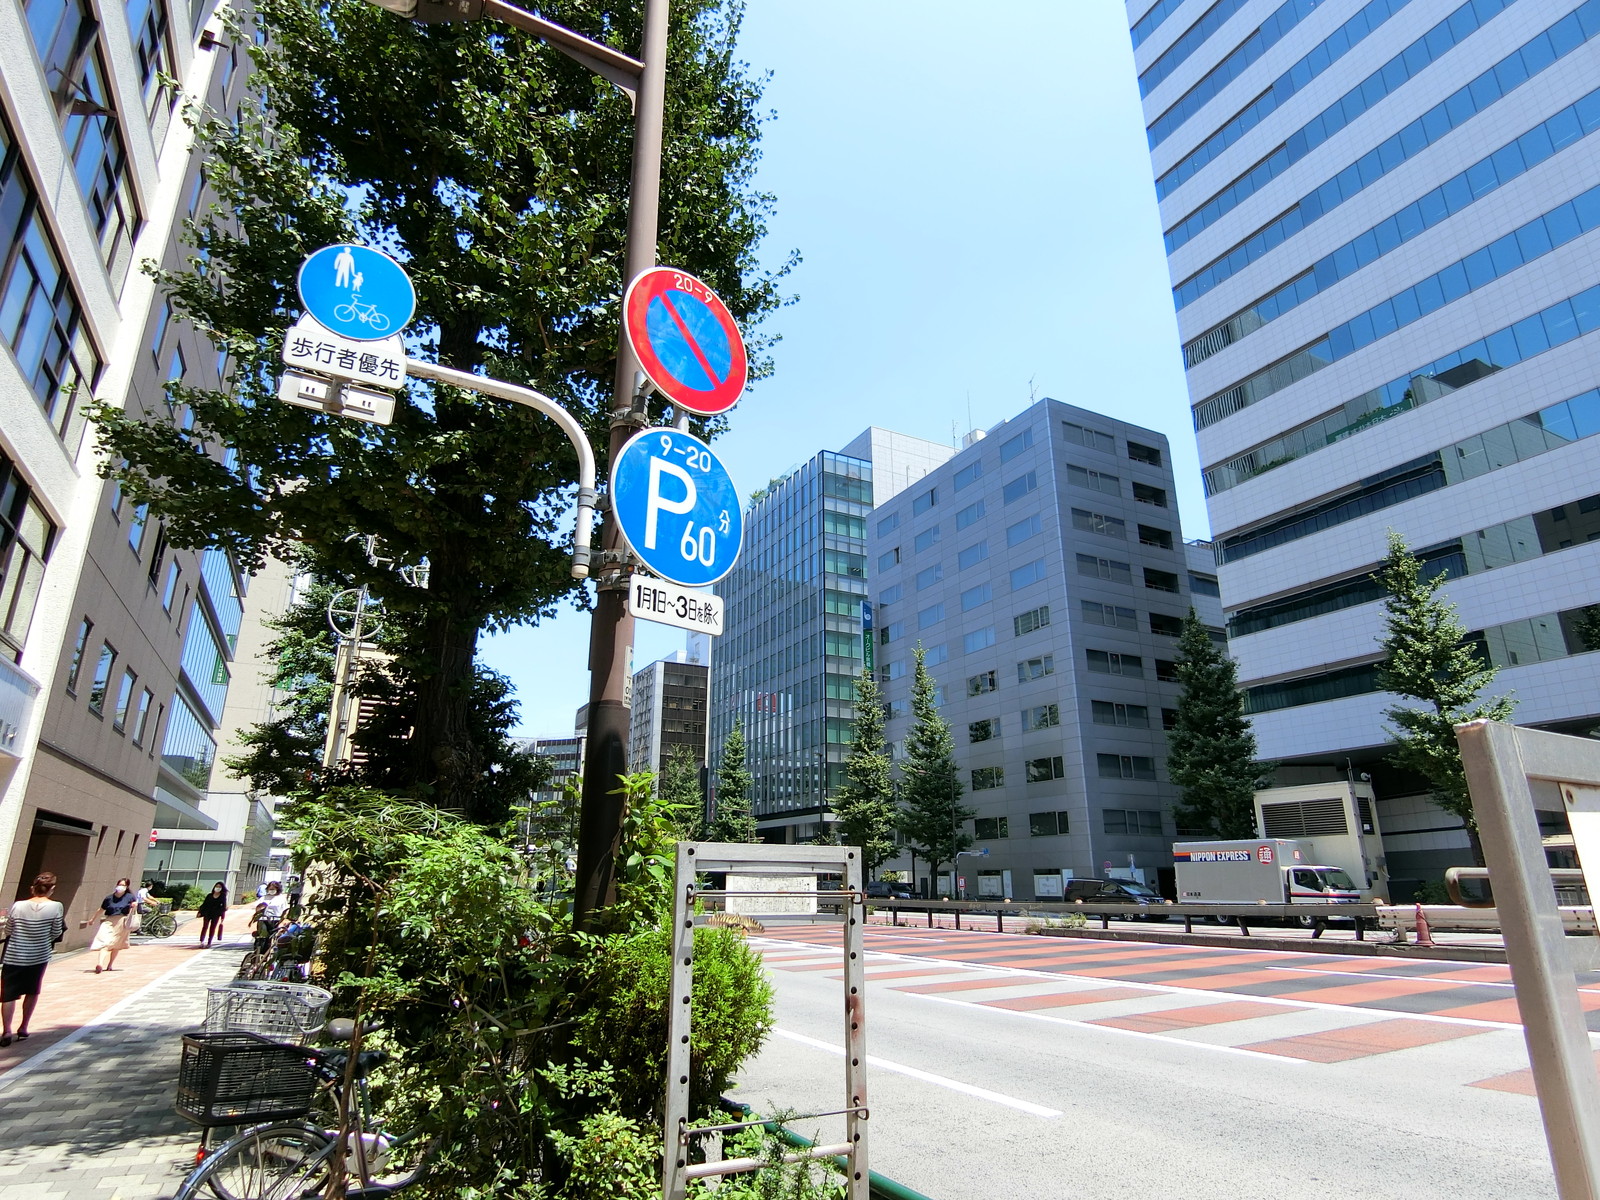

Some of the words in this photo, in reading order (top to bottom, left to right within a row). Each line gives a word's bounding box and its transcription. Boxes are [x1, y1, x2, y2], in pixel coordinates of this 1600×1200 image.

[674, 273, 713, 304] 20-9
[291, 337, 400, 381] 歩行者優先
[660, 435, 711, 473] 9-20
[644, 455, 697, 551] P
[681, 521, 715, 567] 60
[718, 510, 731, 534] 分
[1190, 851, 1216, 862] NIPPON
[1216, 850, 1249, 861] EXPRESS
